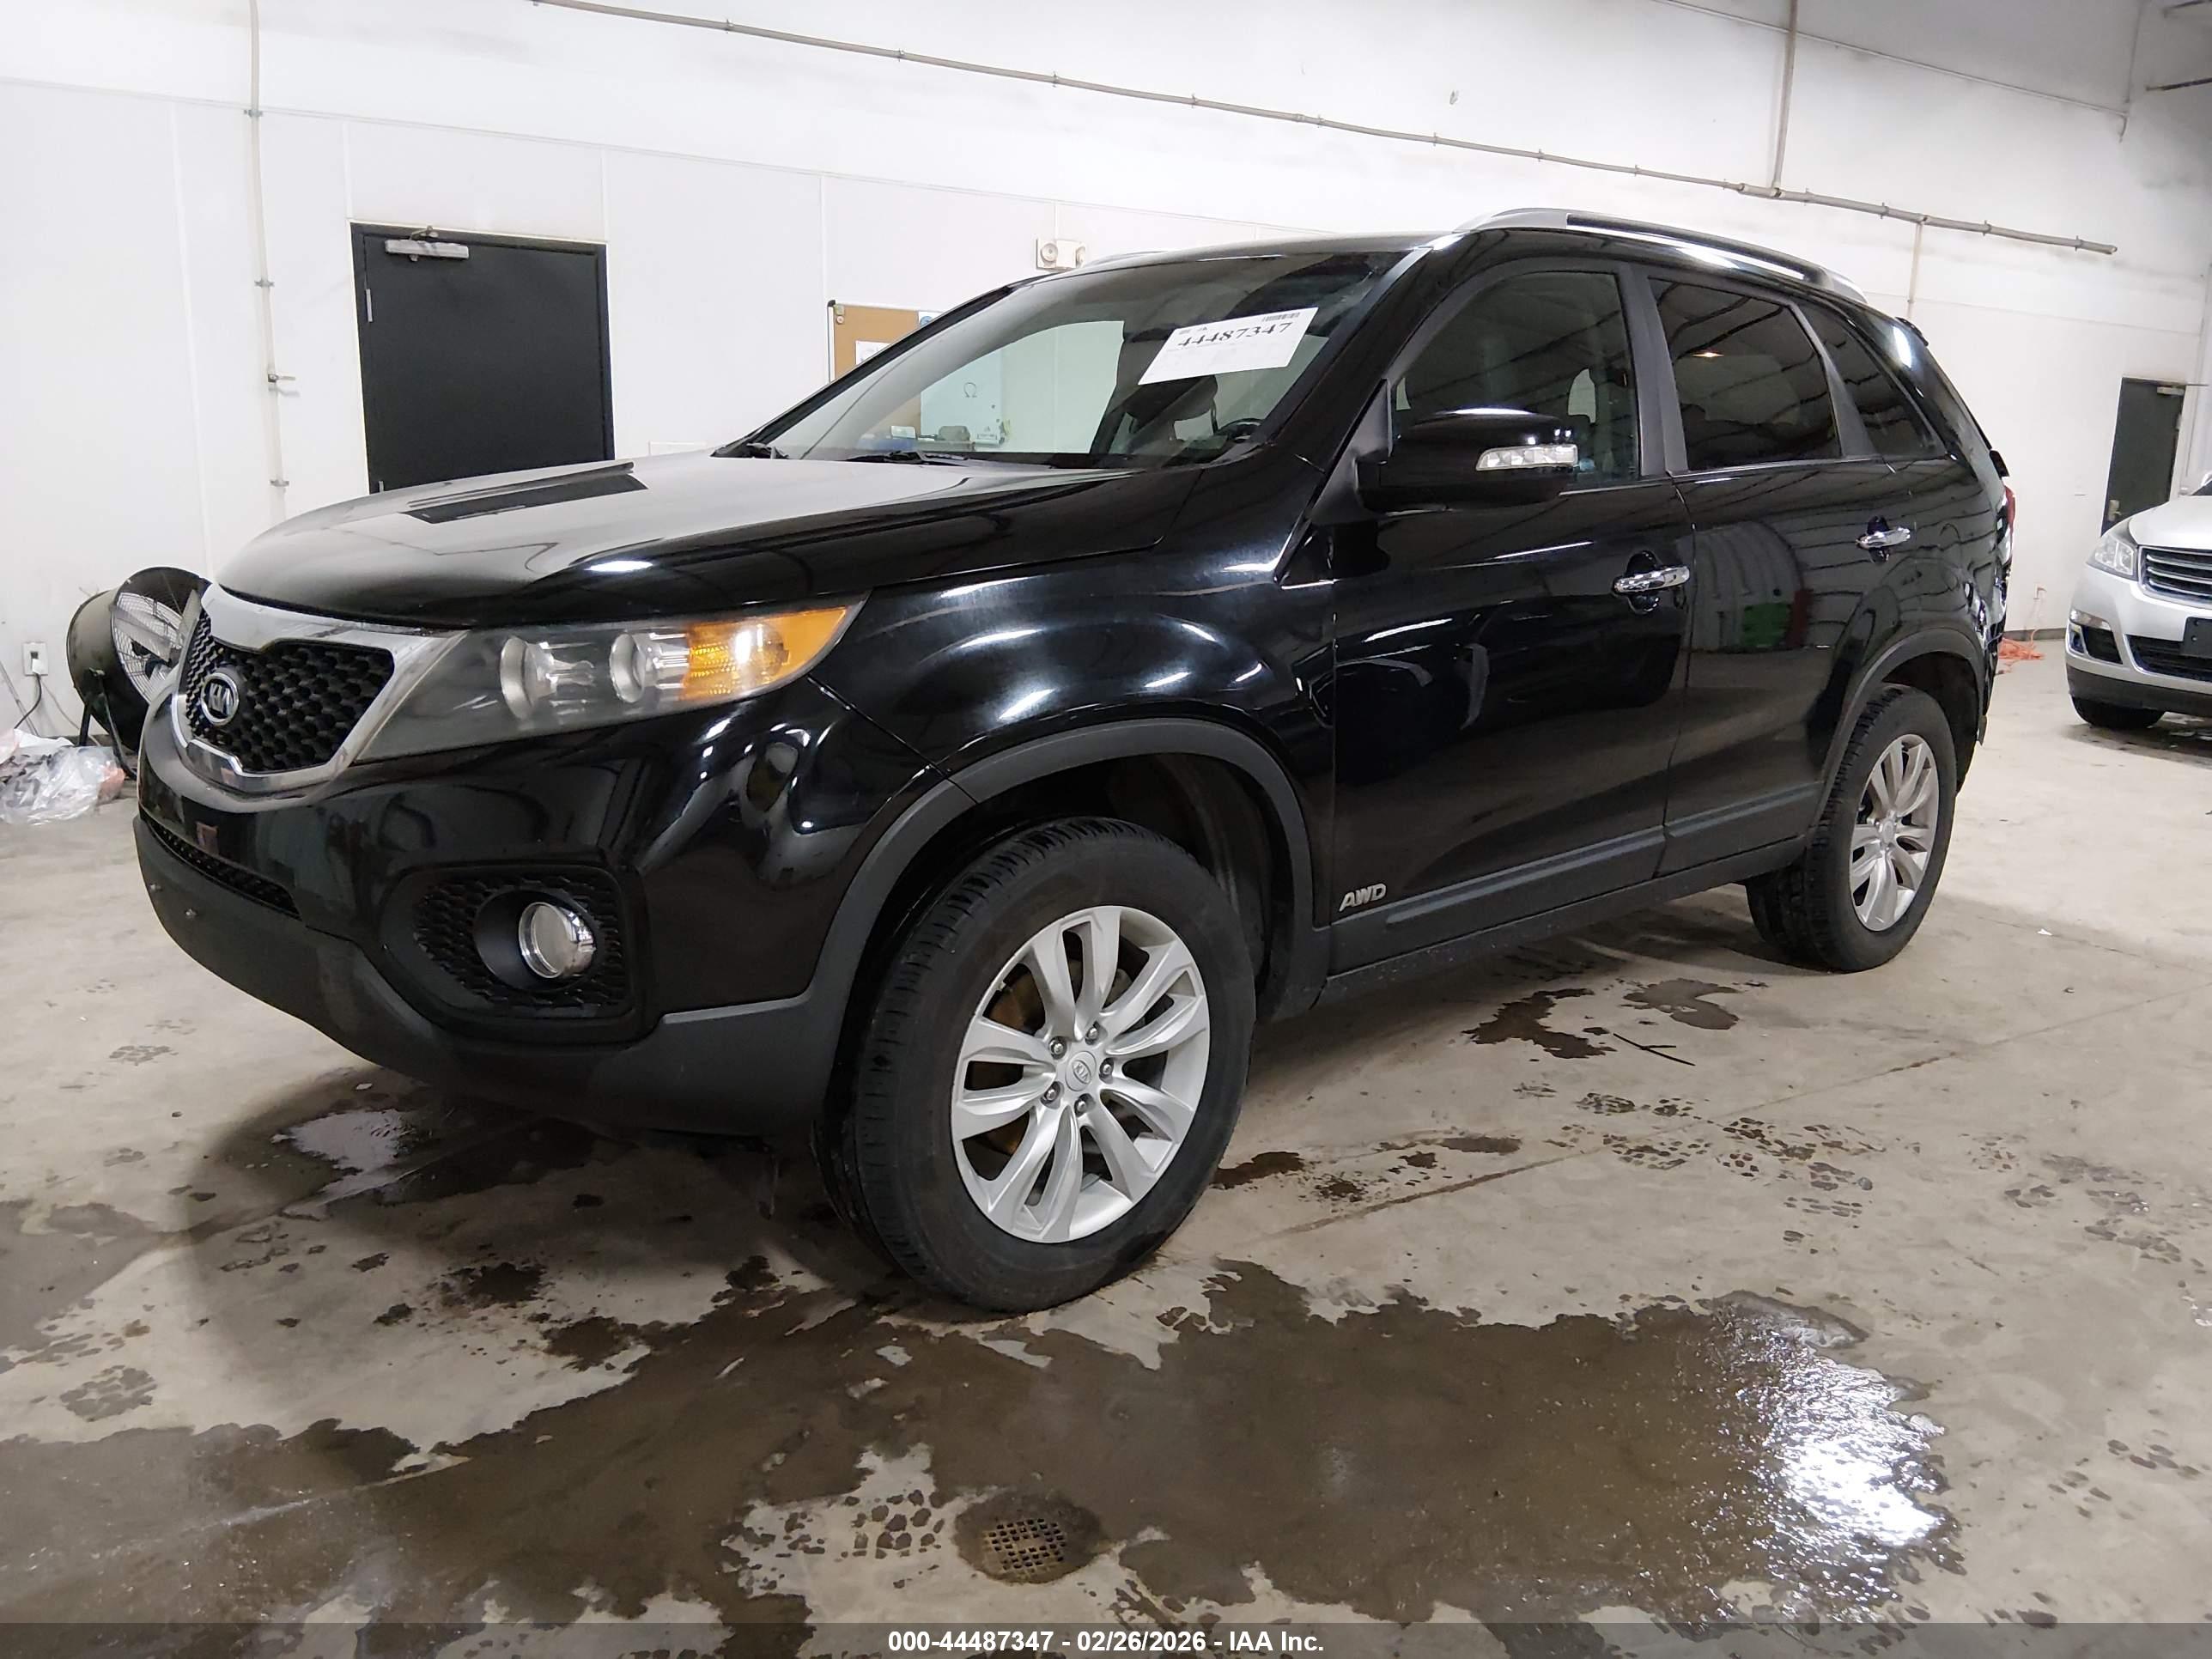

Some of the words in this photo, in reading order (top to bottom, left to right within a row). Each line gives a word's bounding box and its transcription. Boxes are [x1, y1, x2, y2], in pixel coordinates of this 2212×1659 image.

[1177, 322, 1292, 346] 44487347
[1339, 883, 1387, 912] AWD
[1073, 1061, 1091, 1082] KIA
